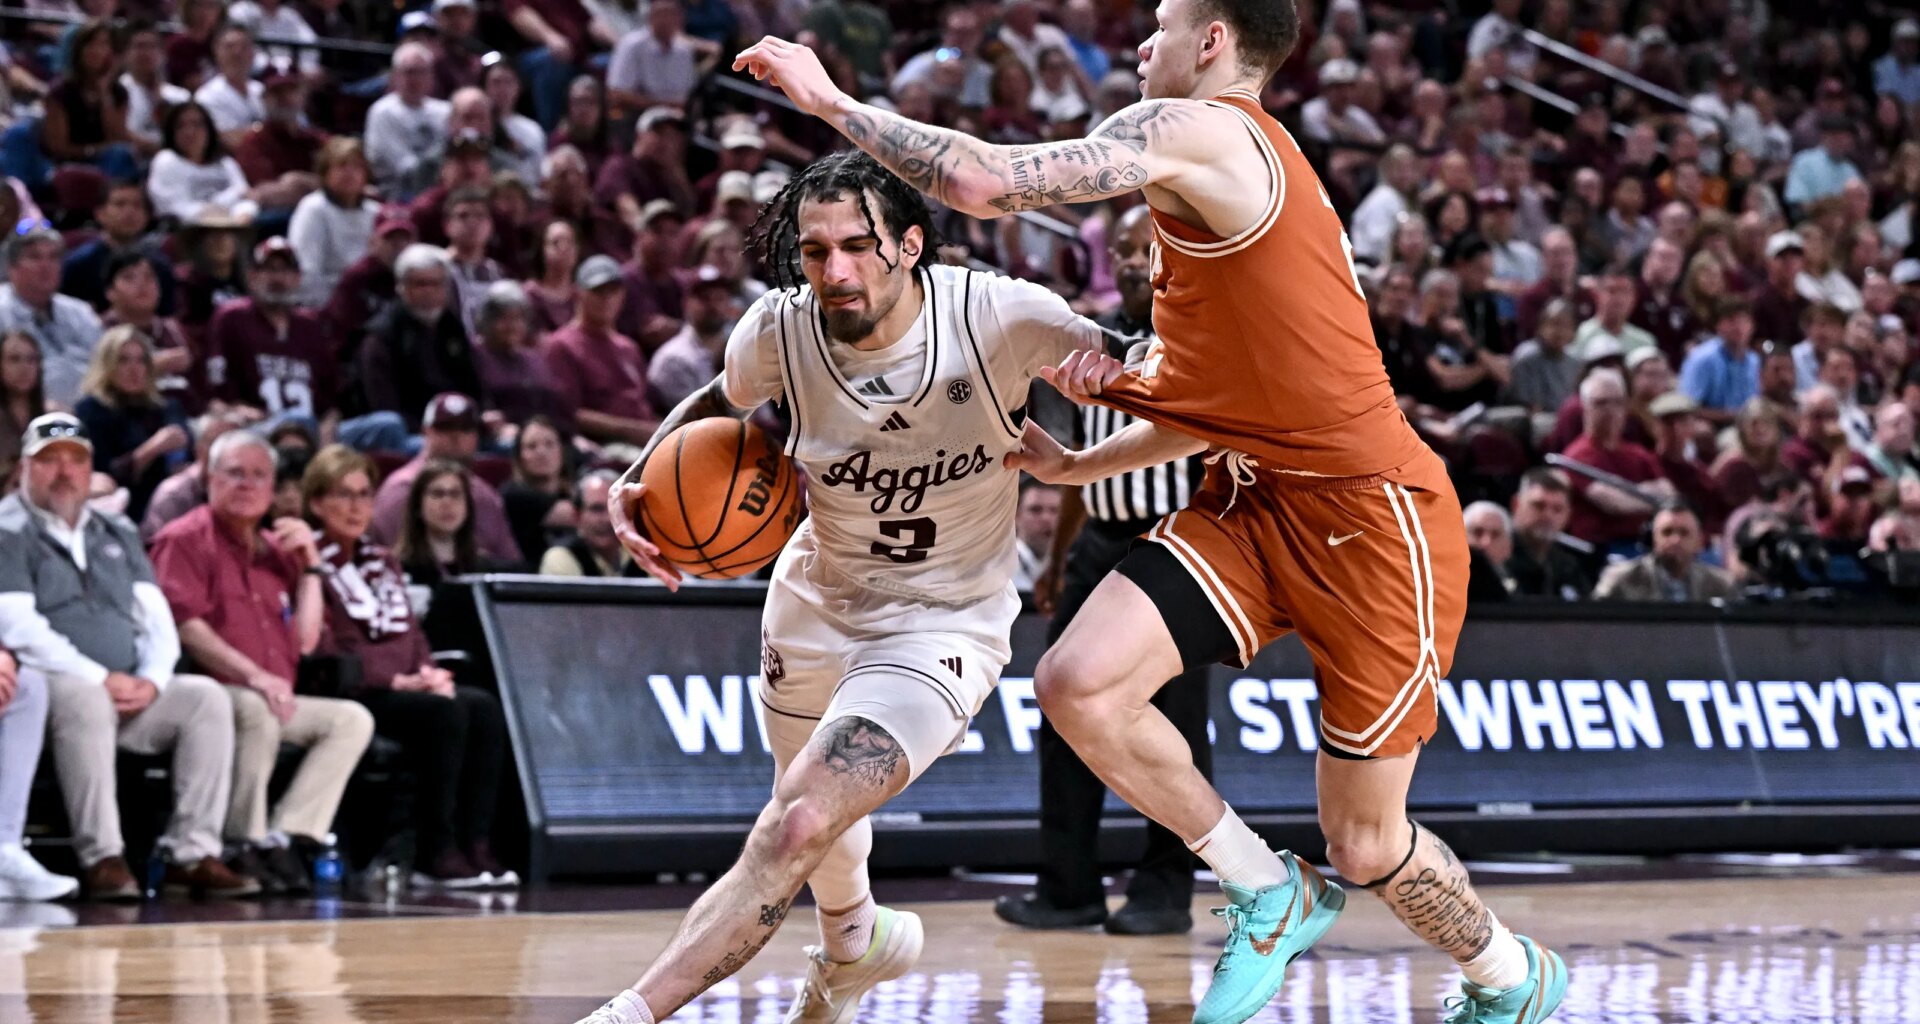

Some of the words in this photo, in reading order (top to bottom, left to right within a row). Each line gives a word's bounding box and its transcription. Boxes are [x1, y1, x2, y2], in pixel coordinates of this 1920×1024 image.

[949, 382, 970, 402] SEC
[821, 444, 994, 514] Aggies
[1228, 678, 1321, 753] ST
[1438, 679, 1664, 751] WHEN
